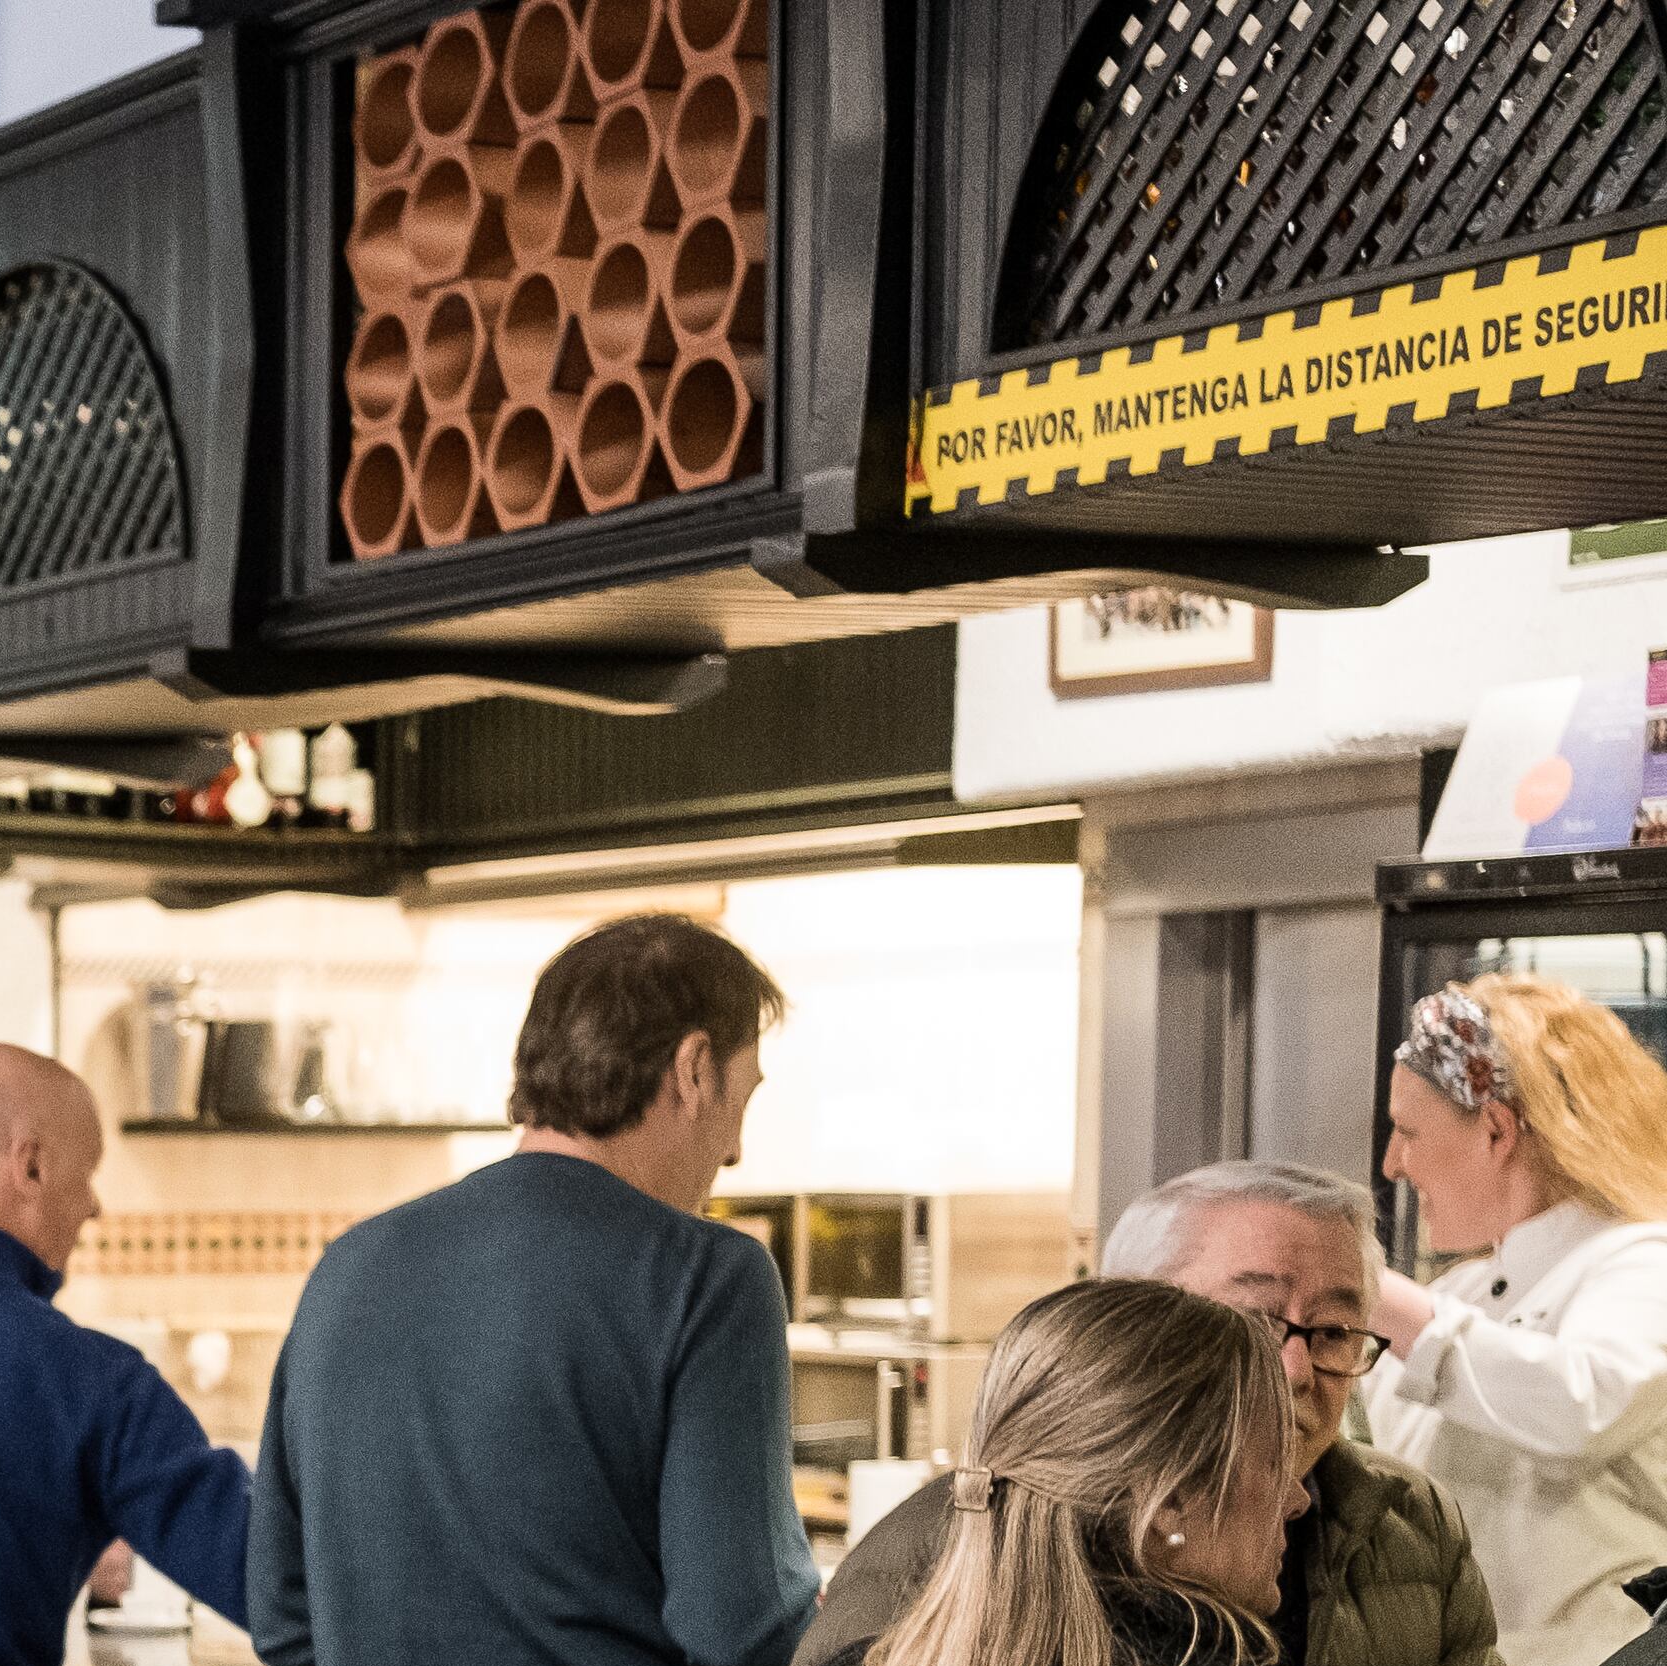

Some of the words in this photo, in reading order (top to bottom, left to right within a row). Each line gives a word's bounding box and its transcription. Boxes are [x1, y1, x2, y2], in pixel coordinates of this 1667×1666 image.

[937, 427, 986, 467] POR
[996, 408, 1083, 457] FAVOR,
[1093, 373, 1249, 437] MANTENGA
[1259, 363, 1295, 403] LA
[1306, 326, 1470, 395] DISTANCIA
[1482, 313, 1523, 358] DE
